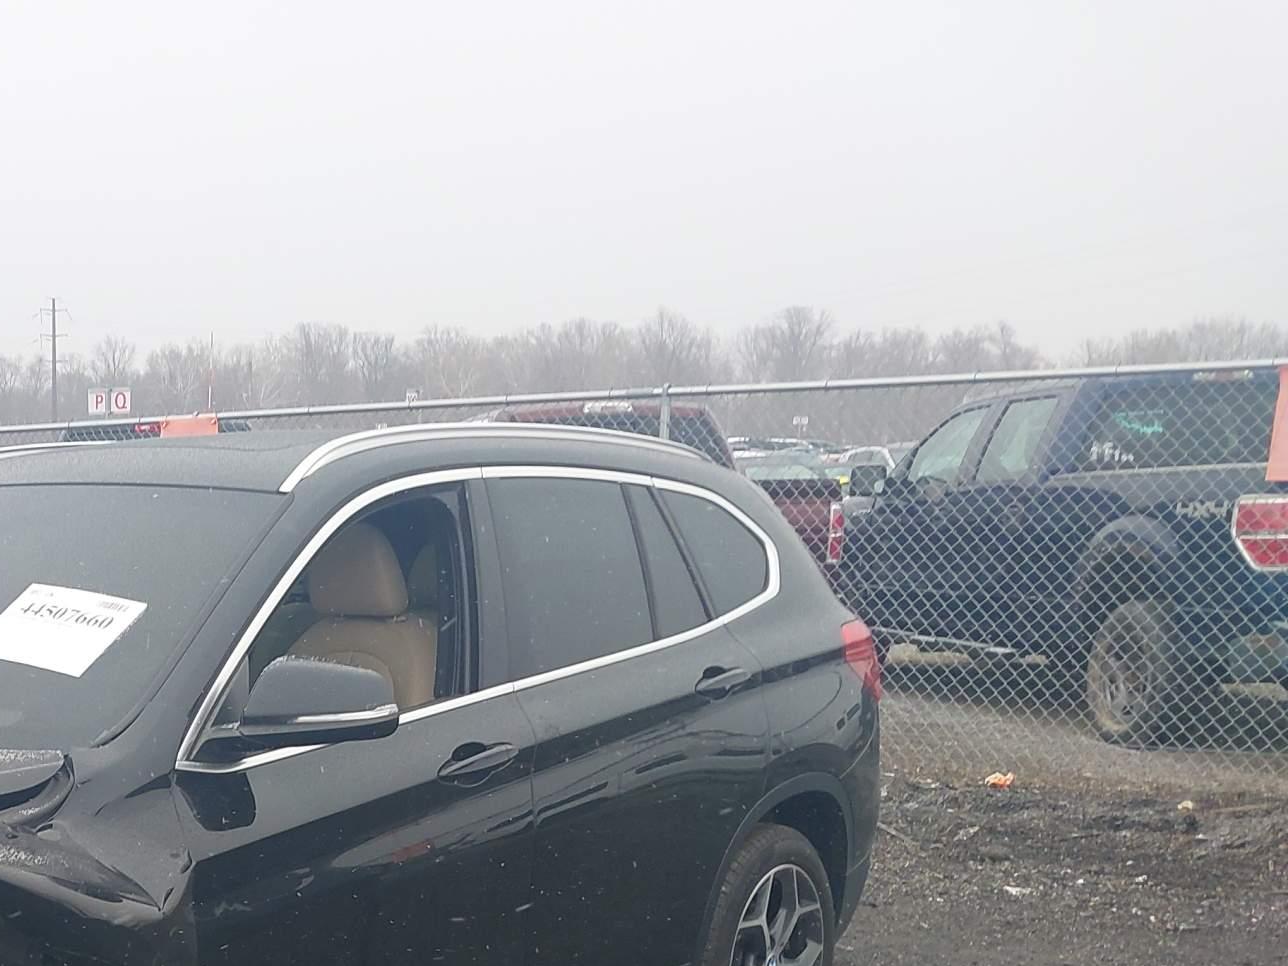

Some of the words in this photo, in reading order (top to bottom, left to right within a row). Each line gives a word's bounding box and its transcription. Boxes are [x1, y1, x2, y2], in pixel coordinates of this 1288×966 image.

[95, 394, 104, 410] P
[114, 391, 127, 410] Q
[20, 602, 114, 630] 44507660
